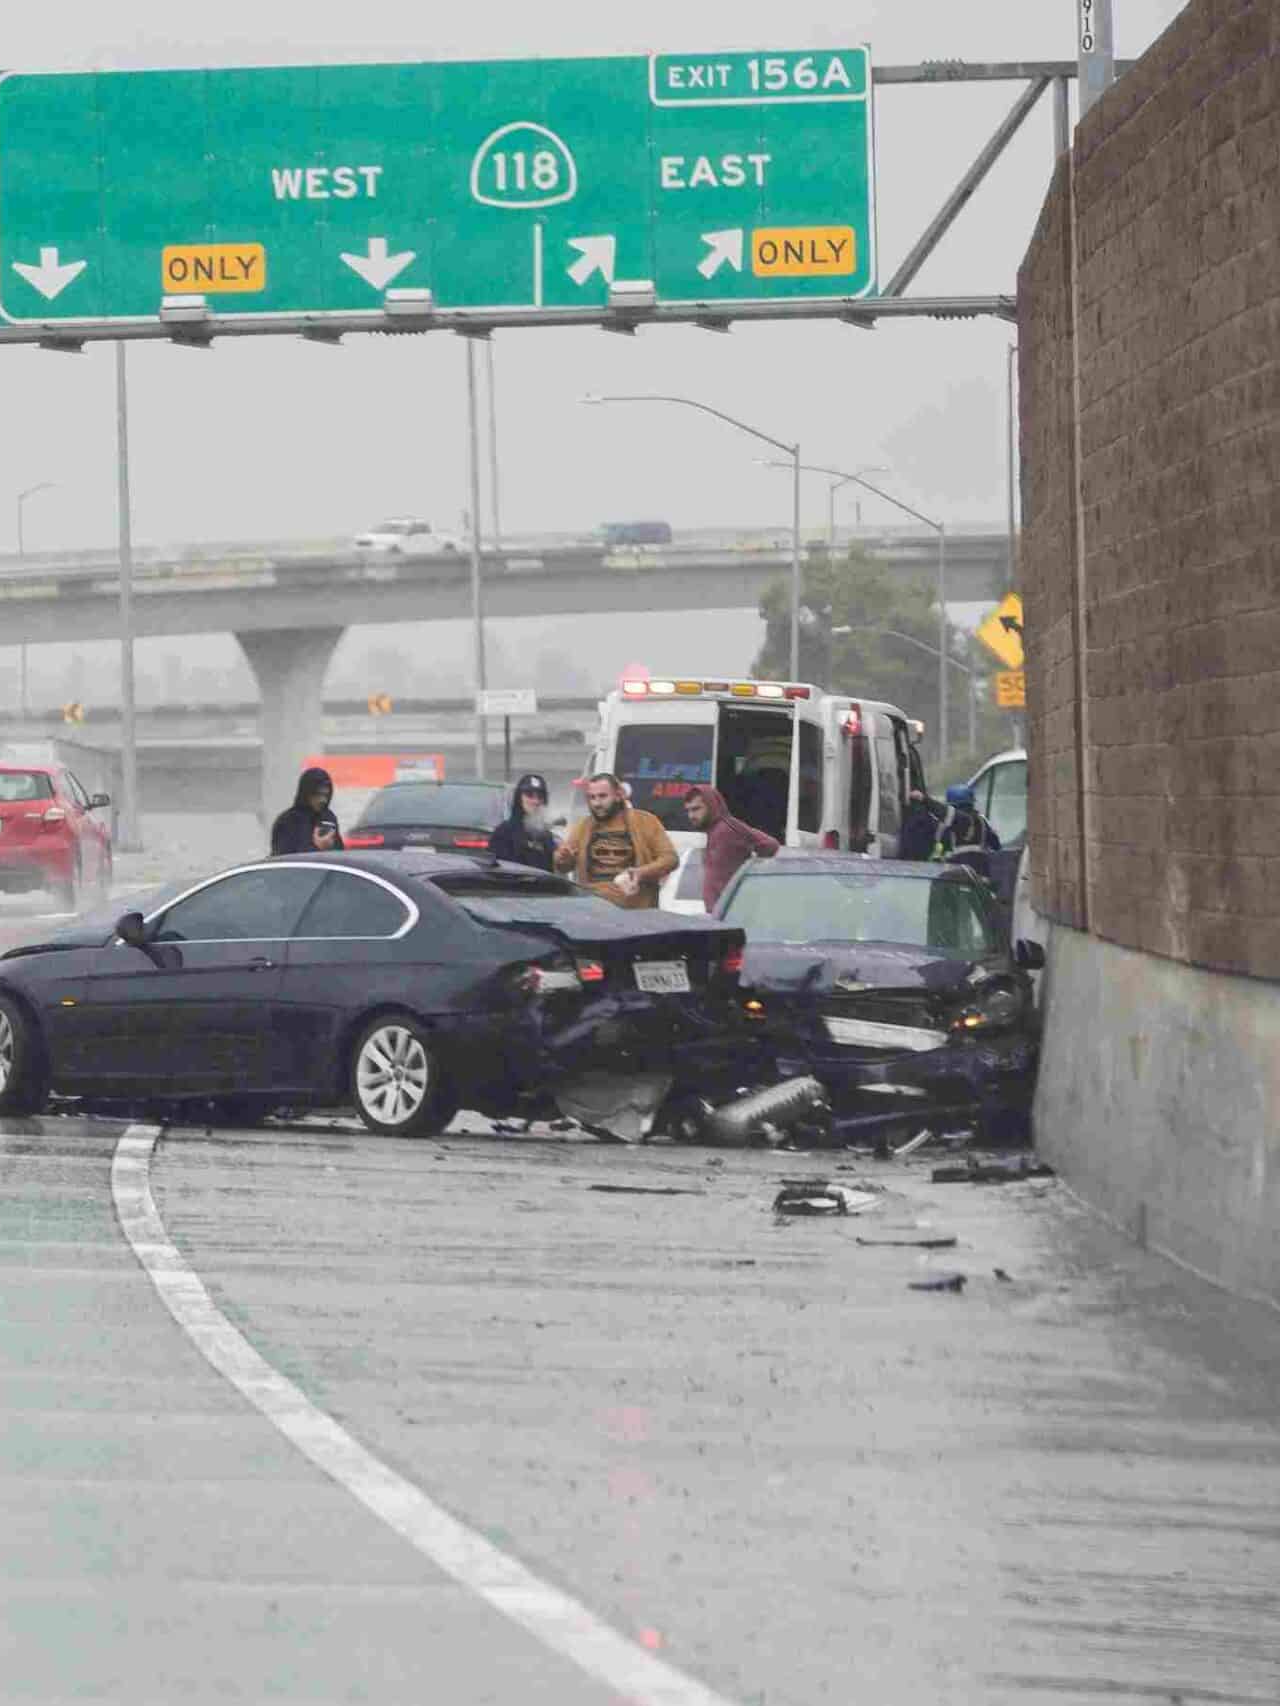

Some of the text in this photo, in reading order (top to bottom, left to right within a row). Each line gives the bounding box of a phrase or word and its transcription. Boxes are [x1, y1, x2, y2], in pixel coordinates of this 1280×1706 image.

[667, 56, 851, 91] EXIT 156A
[271, 166, 382, 200] WEST
[493, 151, 559, 191] 118
[661, 154, 771, 189] EAST
[168, 256, 258, 282] ONLY
[758, 239, 848, 265] ONLY
